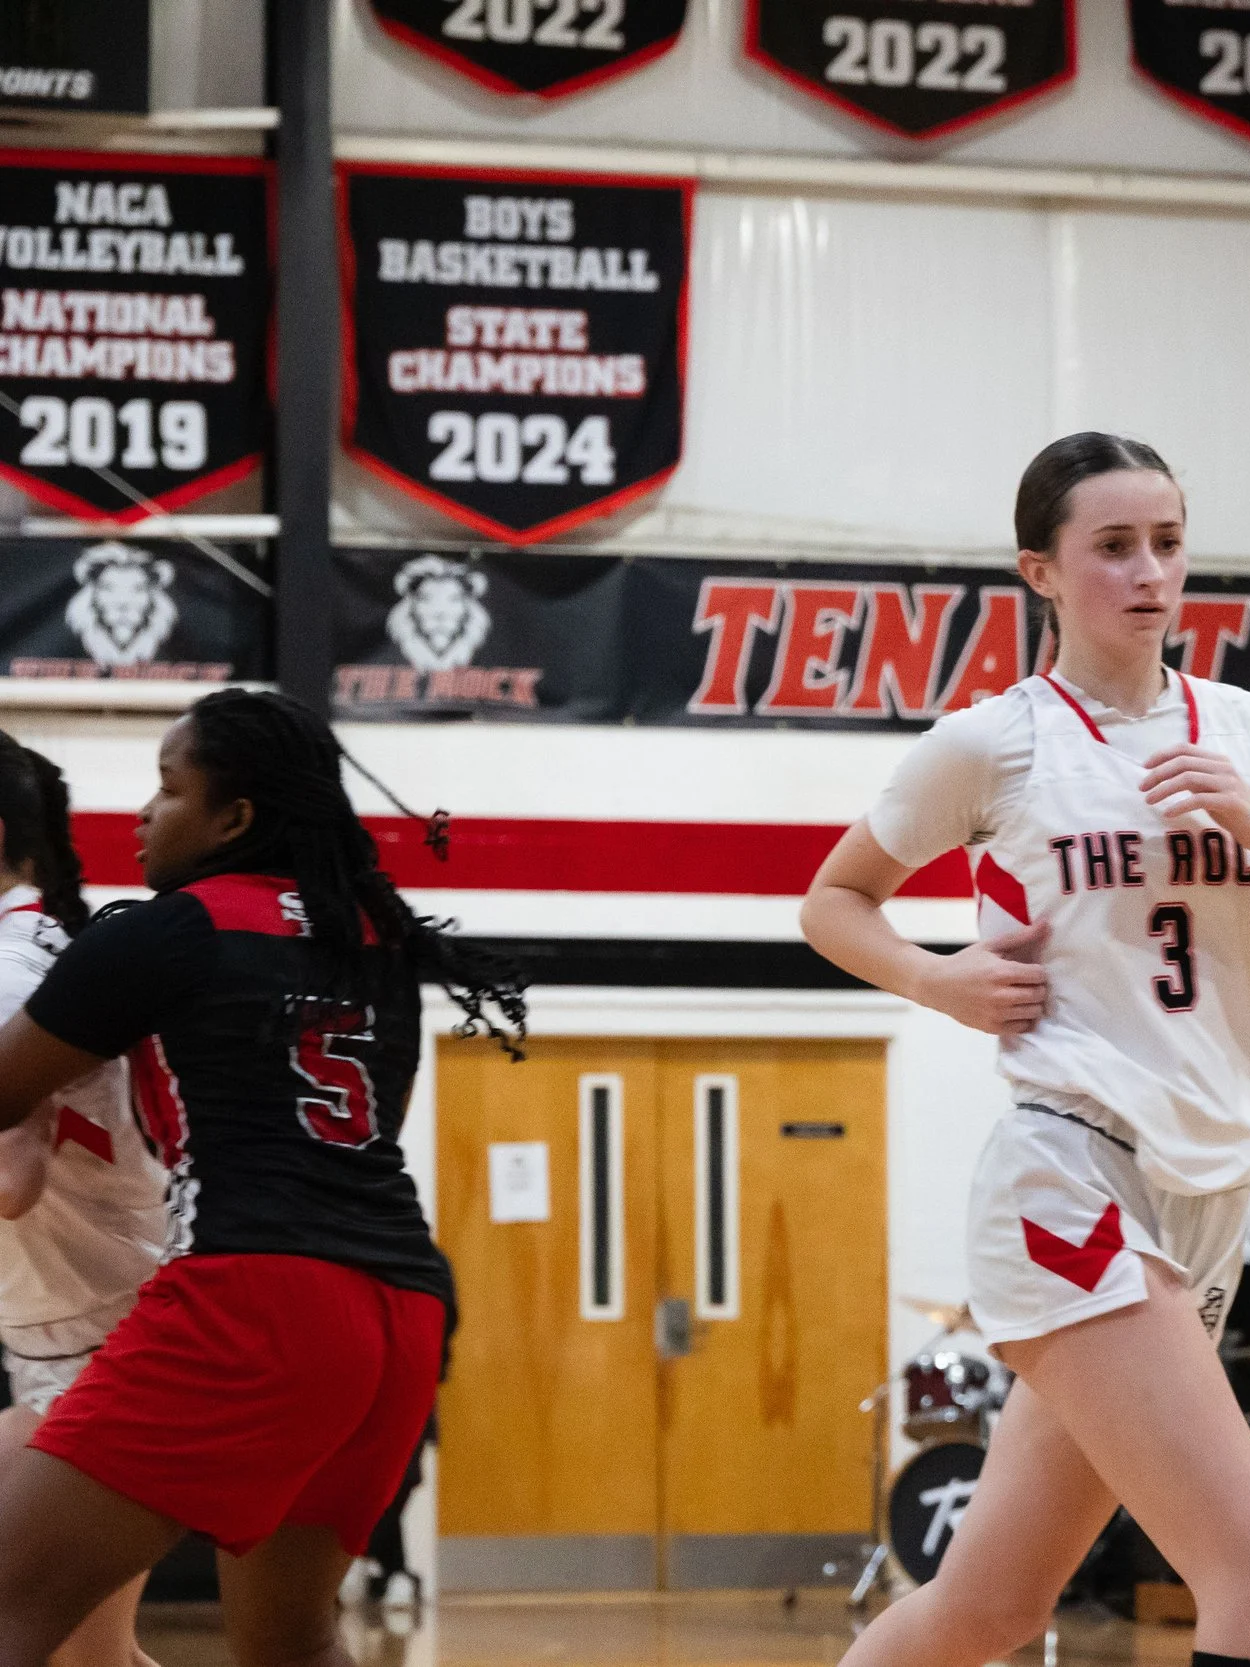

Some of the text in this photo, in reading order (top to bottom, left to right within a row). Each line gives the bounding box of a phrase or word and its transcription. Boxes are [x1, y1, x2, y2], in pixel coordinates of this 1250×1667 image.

[442, 0, 626, 50] 2022
[822, 14, 1008, 93] 2022
[0, 66, 95, 99] OINTS
[53, 180, 173, 228] NACA
[462, 194, 576, 243] BOYS
[377, 238, 660, 293] BASKETBALL
[1, 287, 216, 338] NATIONAL
[446, 304, 590, 352] STATE
[388, 347, 648, 400] CHAMPIONS
[18, 394, 208, 471] 2019
[426, 410, 618, 486] 2024
[1049, 831, 1145, 895] THE
[1147, 900, 1199, 1014] 3
[285, 992, 381, 1151] 5
